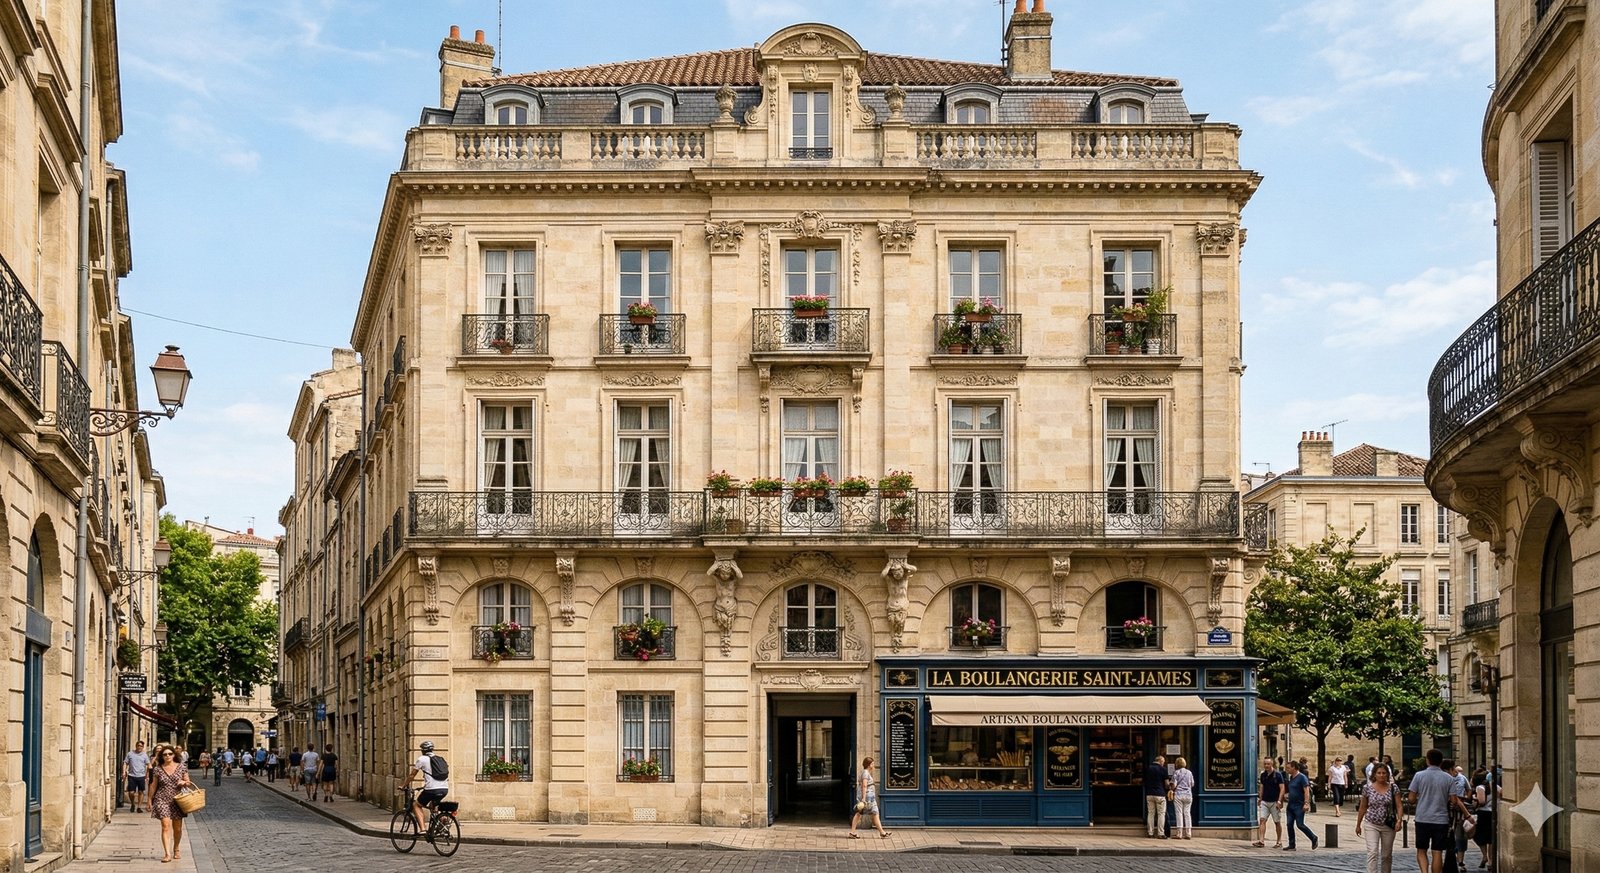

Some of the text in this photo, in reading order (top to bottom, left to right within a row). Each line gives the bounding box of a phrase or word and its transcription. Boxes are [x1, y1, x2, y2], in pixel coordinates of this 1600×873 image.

[933, 671, 1192, 686] LA BOULANGERIE SAINT-JAMES
[980, 715, 1162, 724] ARTISAN BOULANGER PATISSIER
